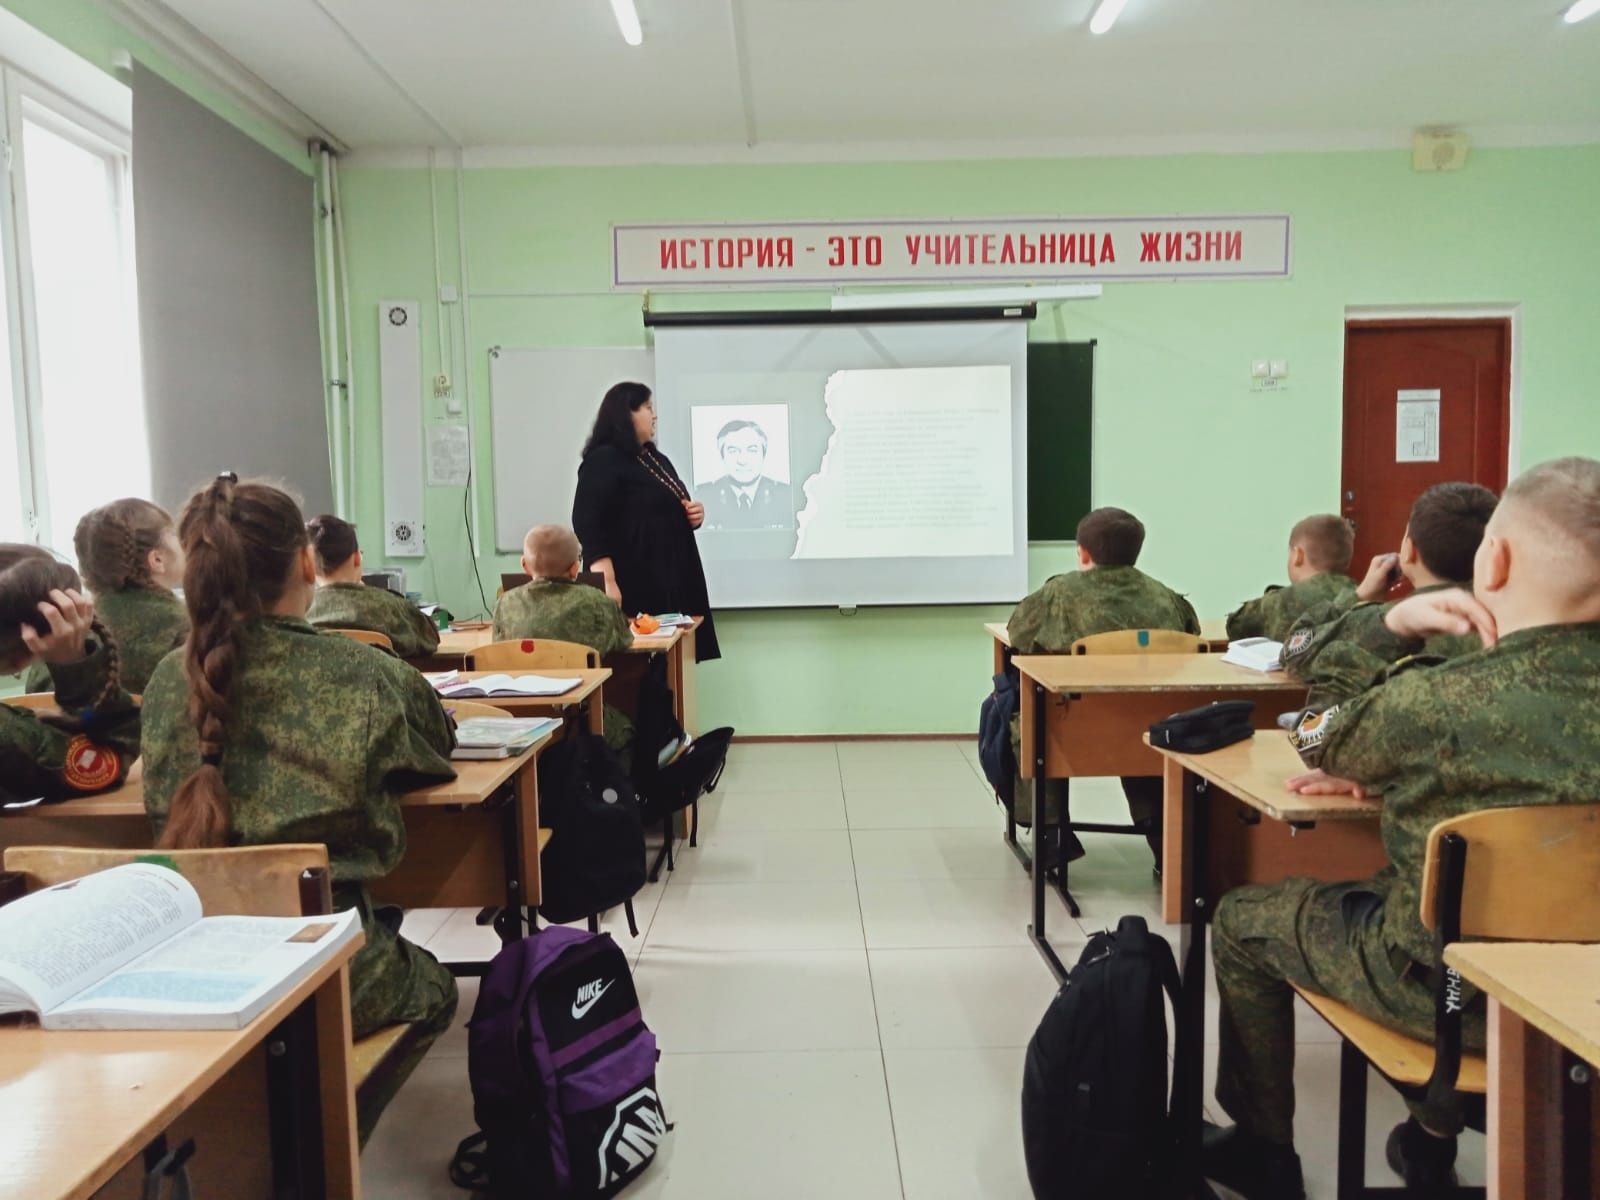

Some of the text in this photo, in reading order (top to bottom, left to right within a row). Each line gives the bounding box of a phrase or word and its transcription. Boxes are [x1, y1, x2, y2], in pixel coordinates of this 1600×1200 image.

[660, 237, 793, 270] ИСТОРИЯ
[828, 235, 883, 267] ЭТО
[905, 233, 1116, 267] УЧИТЕЛЬНИЦА
[1139, 231, 1243, 263] ЖИЗНИ
[576, 978, 603, 1005] NIKE
